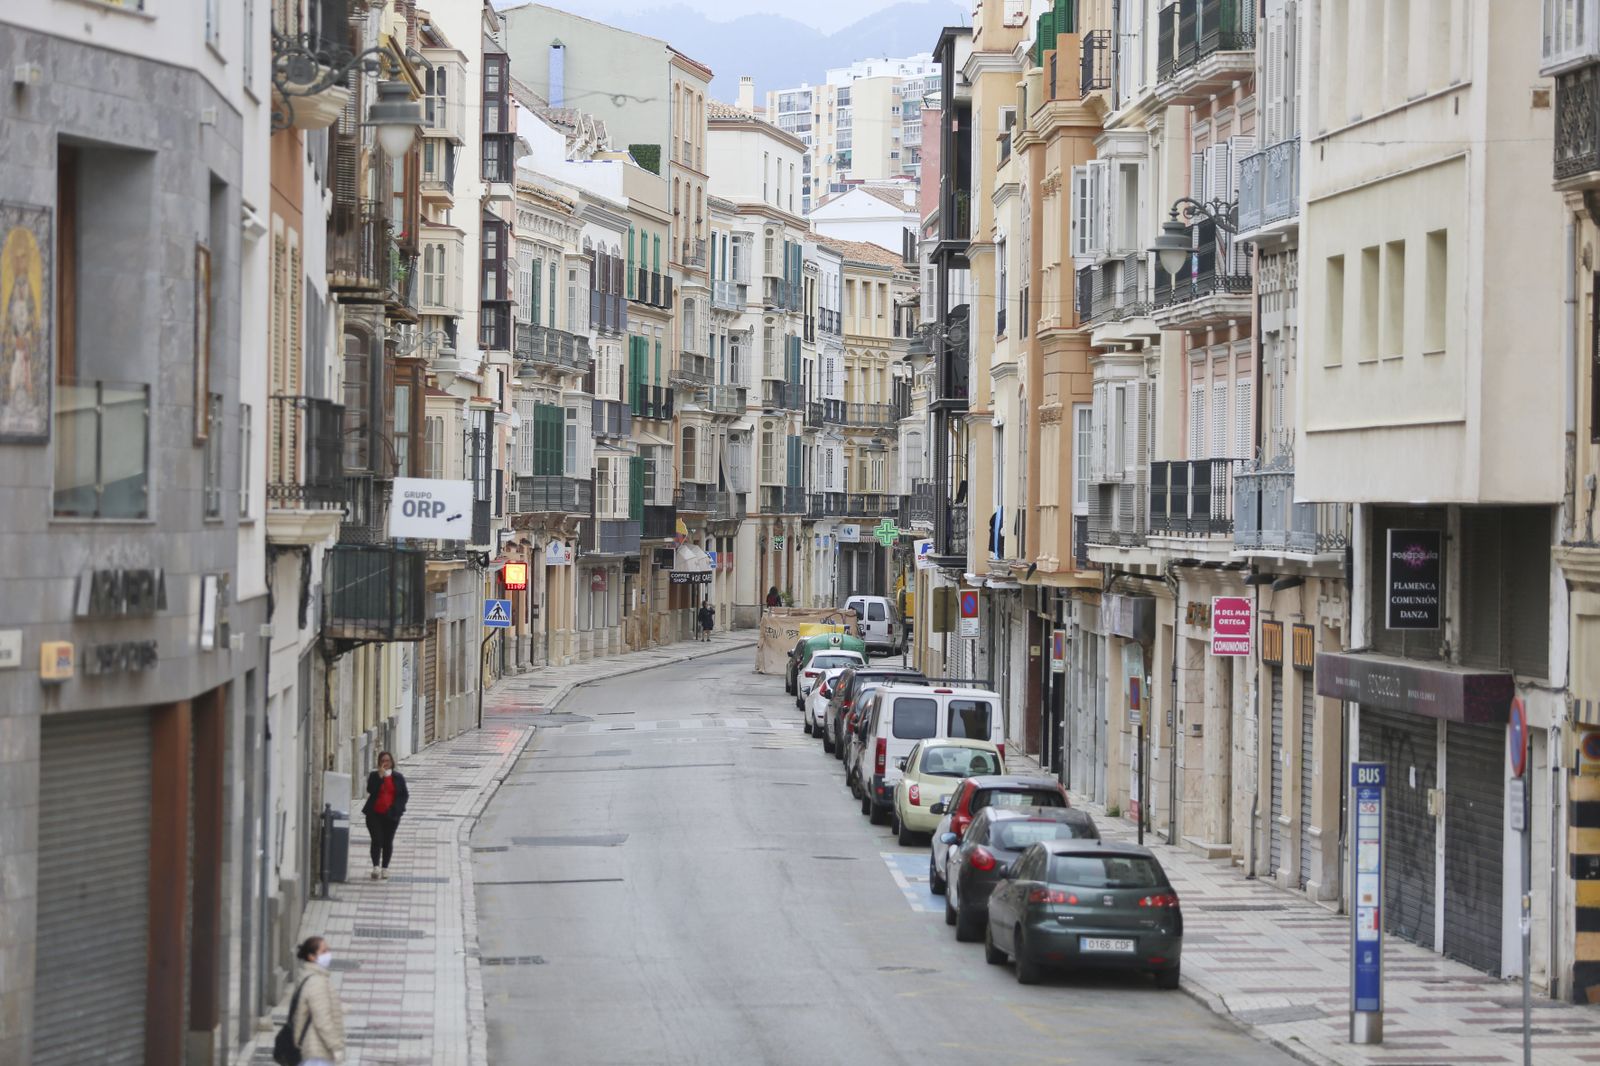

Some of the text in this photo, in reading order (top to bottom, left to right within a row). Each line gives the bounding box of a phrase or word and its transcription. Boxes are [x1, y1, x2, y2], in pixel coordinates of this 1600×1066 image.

[404, 491, 432, 499] GRUPO
[402, 499, 446, 518] ORP
[1393, 582, 1436, 590] FLAMENCA
[1391, 595, 1438, 604] COMUNIÓN
[1400, 610, 1429, 619] DANZA
[1214, 641, 1249, 652] COMUNIONES
[1358, 768, 1380, 783] BUS
[1088, 941, 1131, 949] 0166 CDF
